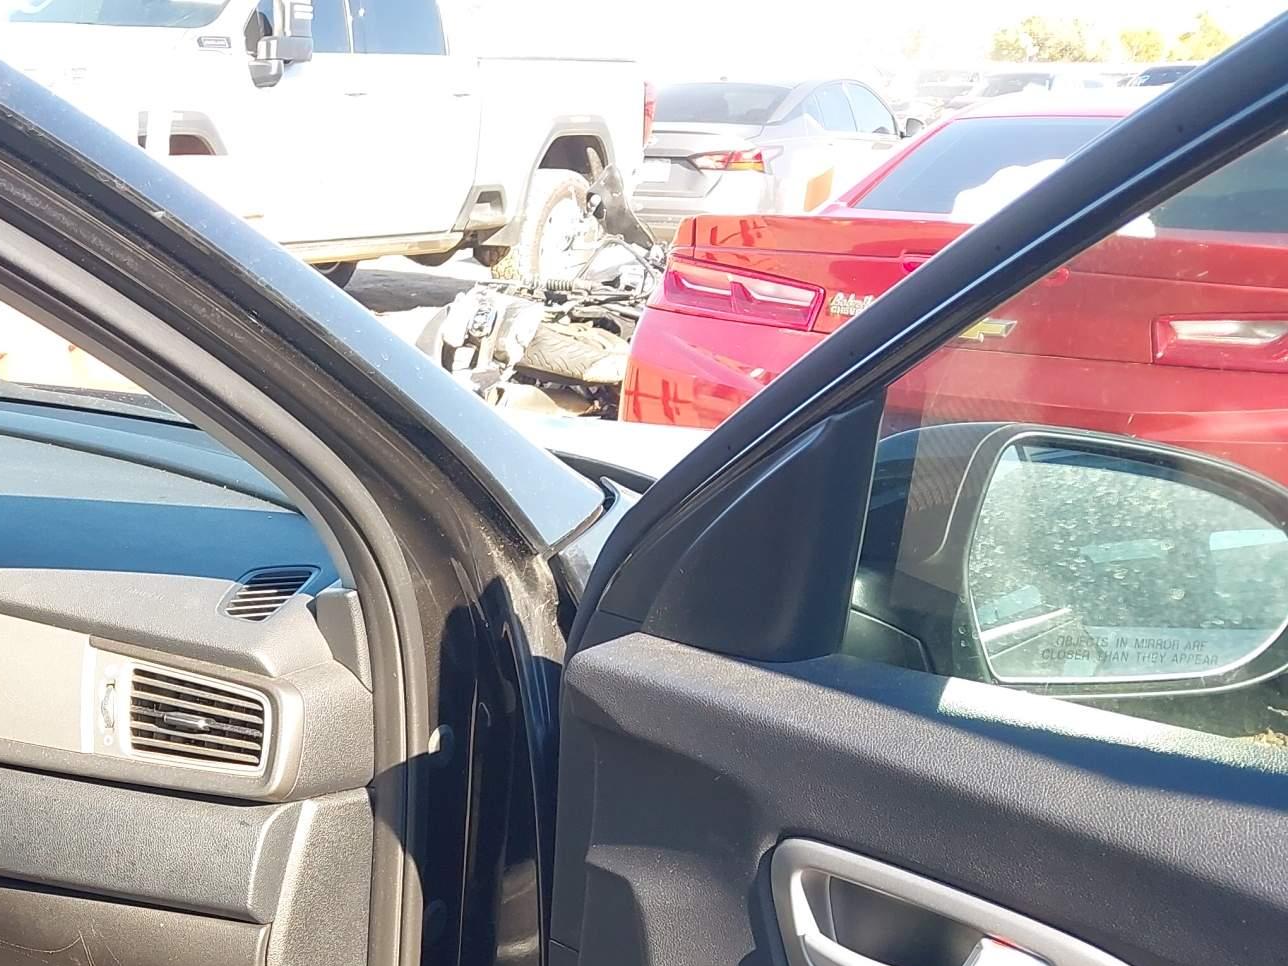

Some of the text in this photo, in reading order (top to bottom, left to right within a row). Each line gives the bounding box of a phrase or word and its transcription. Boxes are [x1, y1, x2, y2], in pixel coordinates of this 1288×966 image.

[1055, 635, 1109, 648] OBJECTS
[1115, 637, 1128, 648] IN
[1134, 638, 1180, 650] MIRROR
[1041, 648, 1219, 665] CLOSER THAN THEY APPEAR
